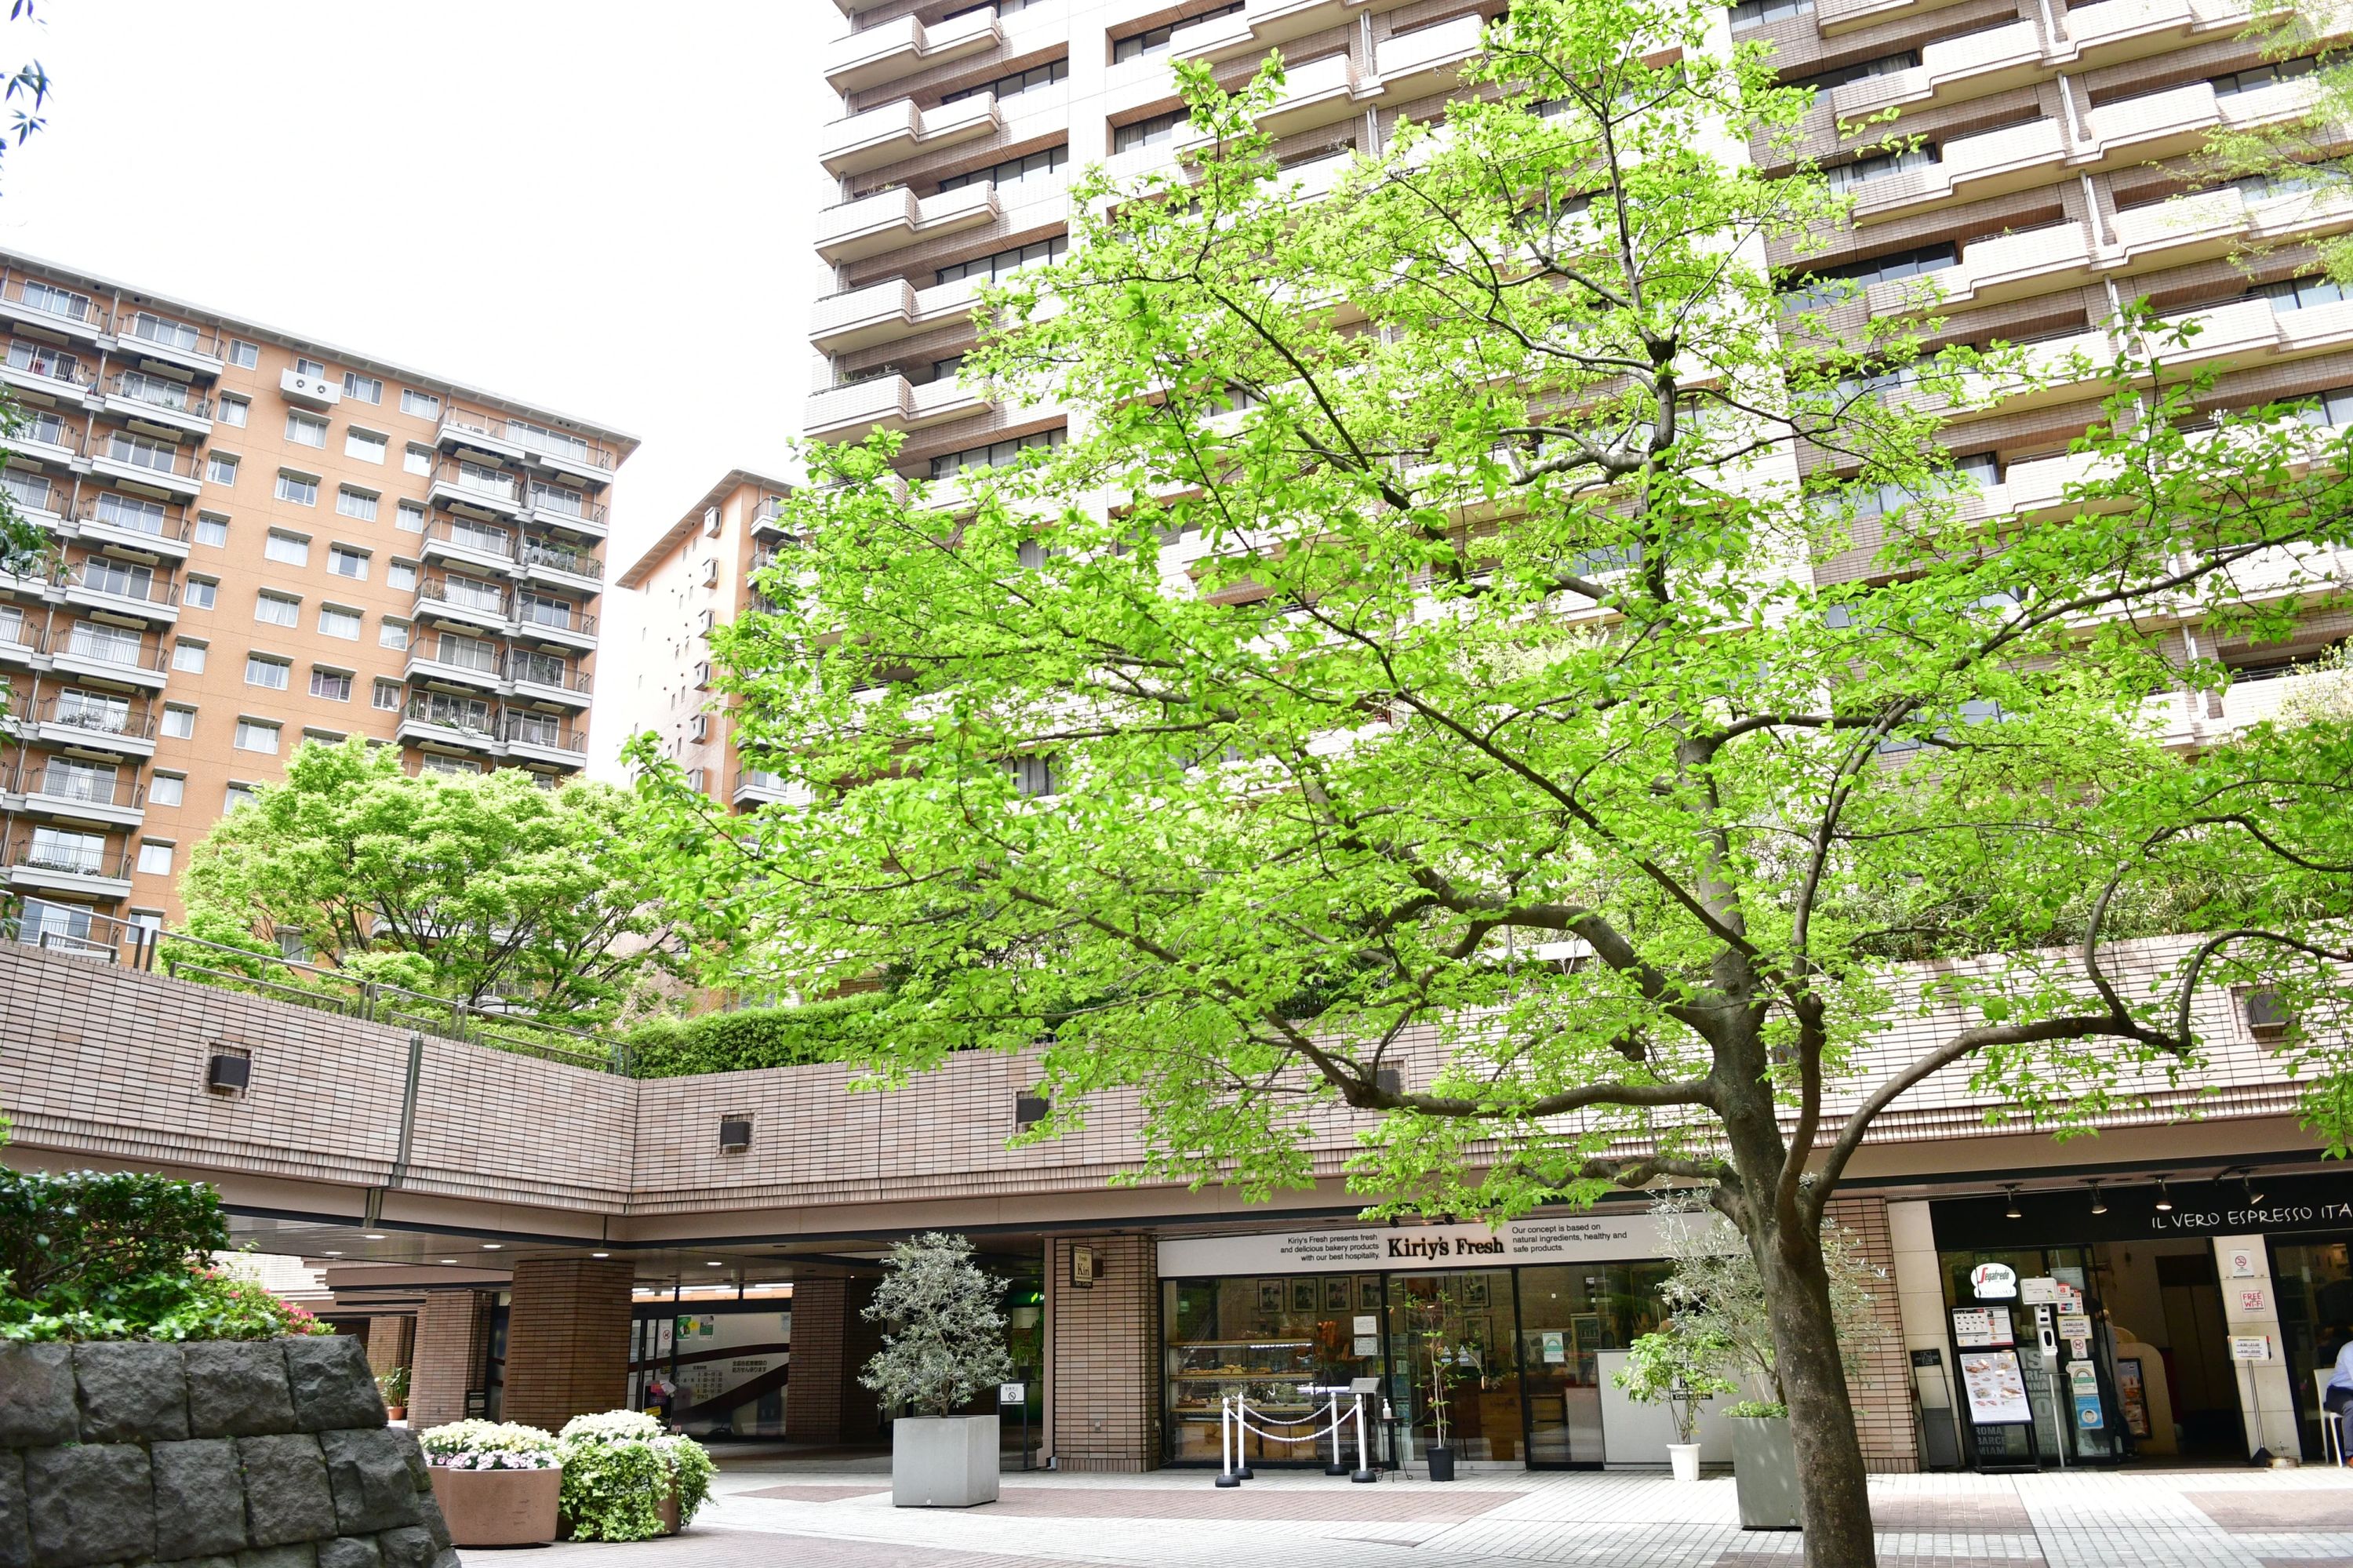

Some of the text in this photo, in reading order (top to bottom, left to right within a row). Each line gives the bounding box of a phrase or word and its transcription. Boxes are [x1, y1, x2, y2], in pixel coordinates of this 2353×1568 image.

[2151, 1217, 2167, 1228] IL
[2171, 1212, 2220, 1228] VERO
[2228, 1206, 2313, 1224] ESPRESSO
[1527, 1224, 1557, 1234] concept
[1566, 1223, 1589, 1231] based
[1287, 1236, 1308, 1245] Kiriy's
[1329, 1235, 1358, 1243] presents
[1512, 1235, 1537, 1243] natural
[1539, 1233, 1582, 1244] ingredients,
[1584, 1232, 1610, 1241] healthy
[1294, 1244, 1324, 1253] delicious
[1325, 1243, 1348, 1253] bakery
[1349, 1242, 1380, 1251] products
[1387, 1236, 1505, 1261] Kiriy's Fresh
[1513, 1244, 1564, 1253] safe products.
[1345, 1252, 1380, 1261] hospitality.
[1977, 1267, 2009, 1284] Segafredo
